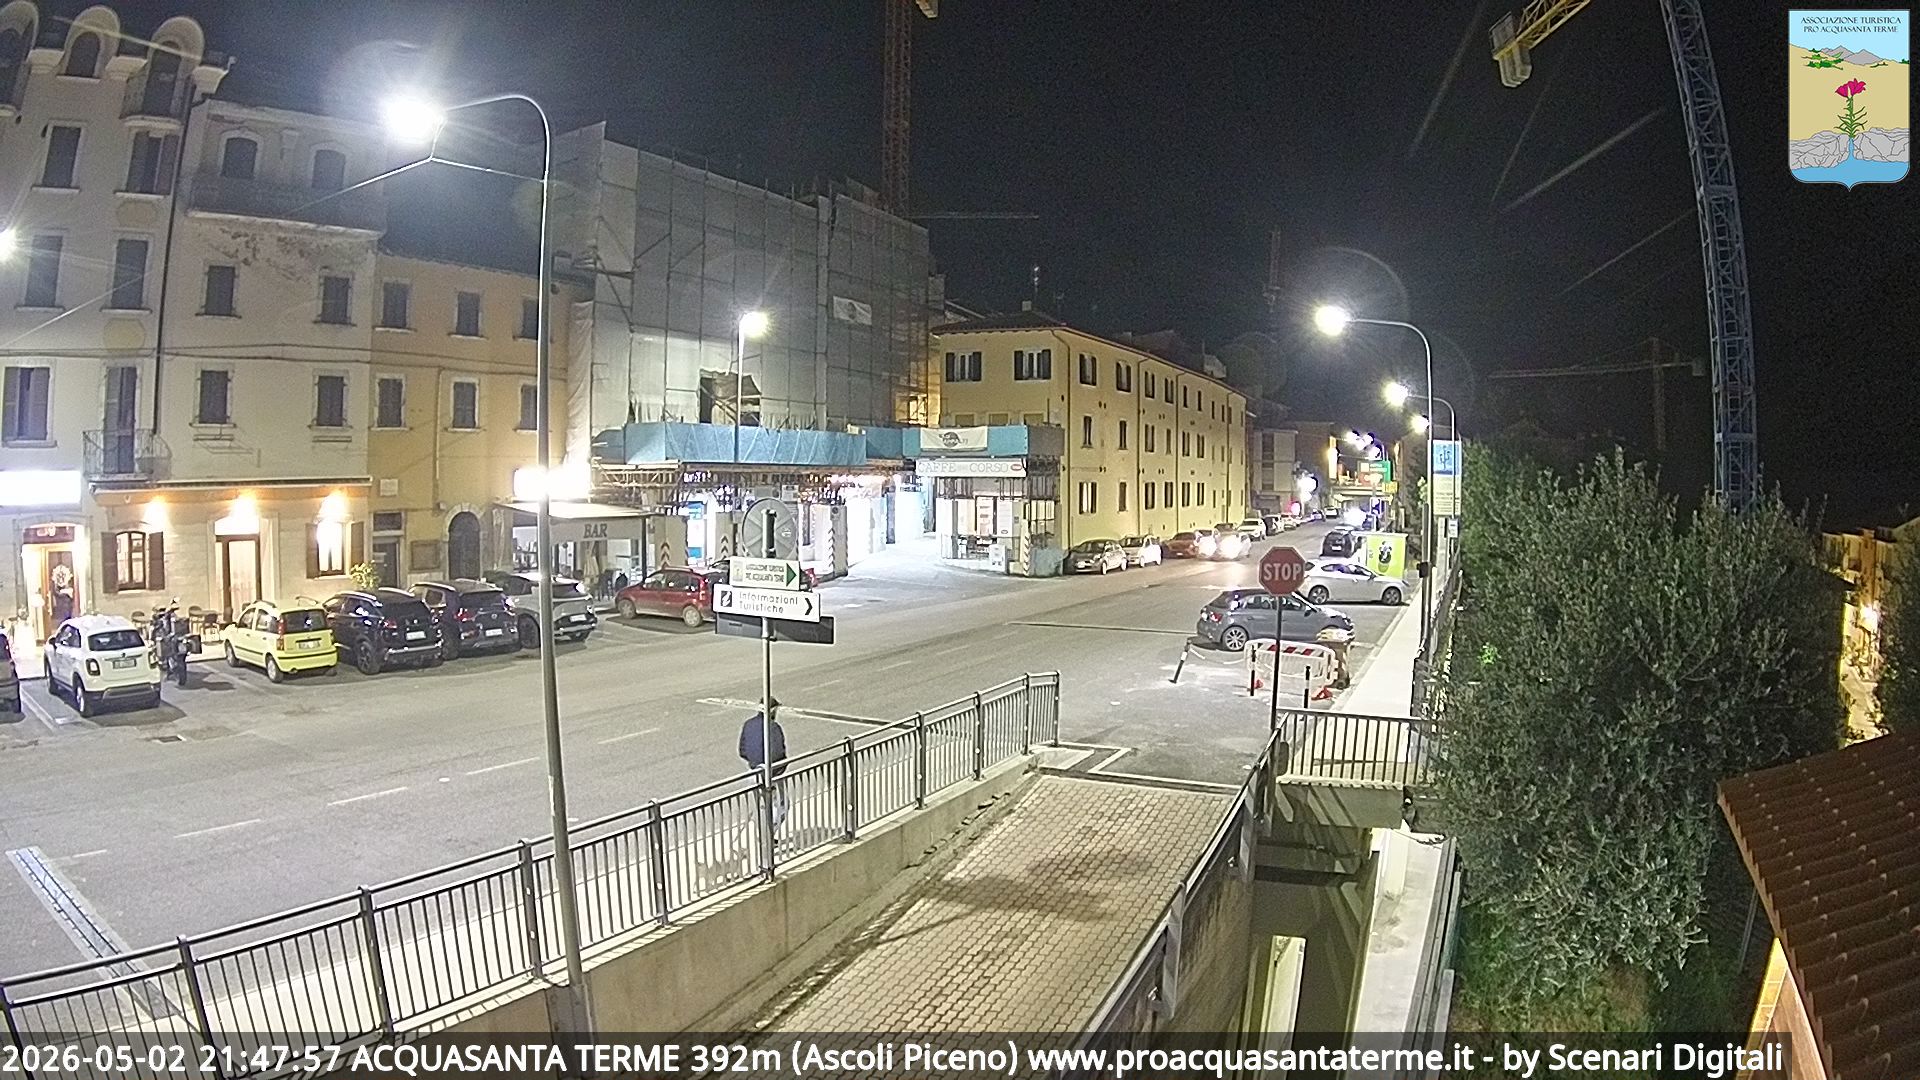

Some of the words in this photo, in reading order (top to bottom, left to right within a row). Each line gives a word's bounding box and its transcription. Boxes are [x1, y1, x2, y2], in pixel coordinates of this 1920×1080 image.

[969, 462, 1009, 473] CORSO
[583, 523, 608, 538] BAR
[1263, 562, 1302, 581] STOP
[739, 592, 798, 605] Informazioni
[739, 600, 784, 614] Turistiche
